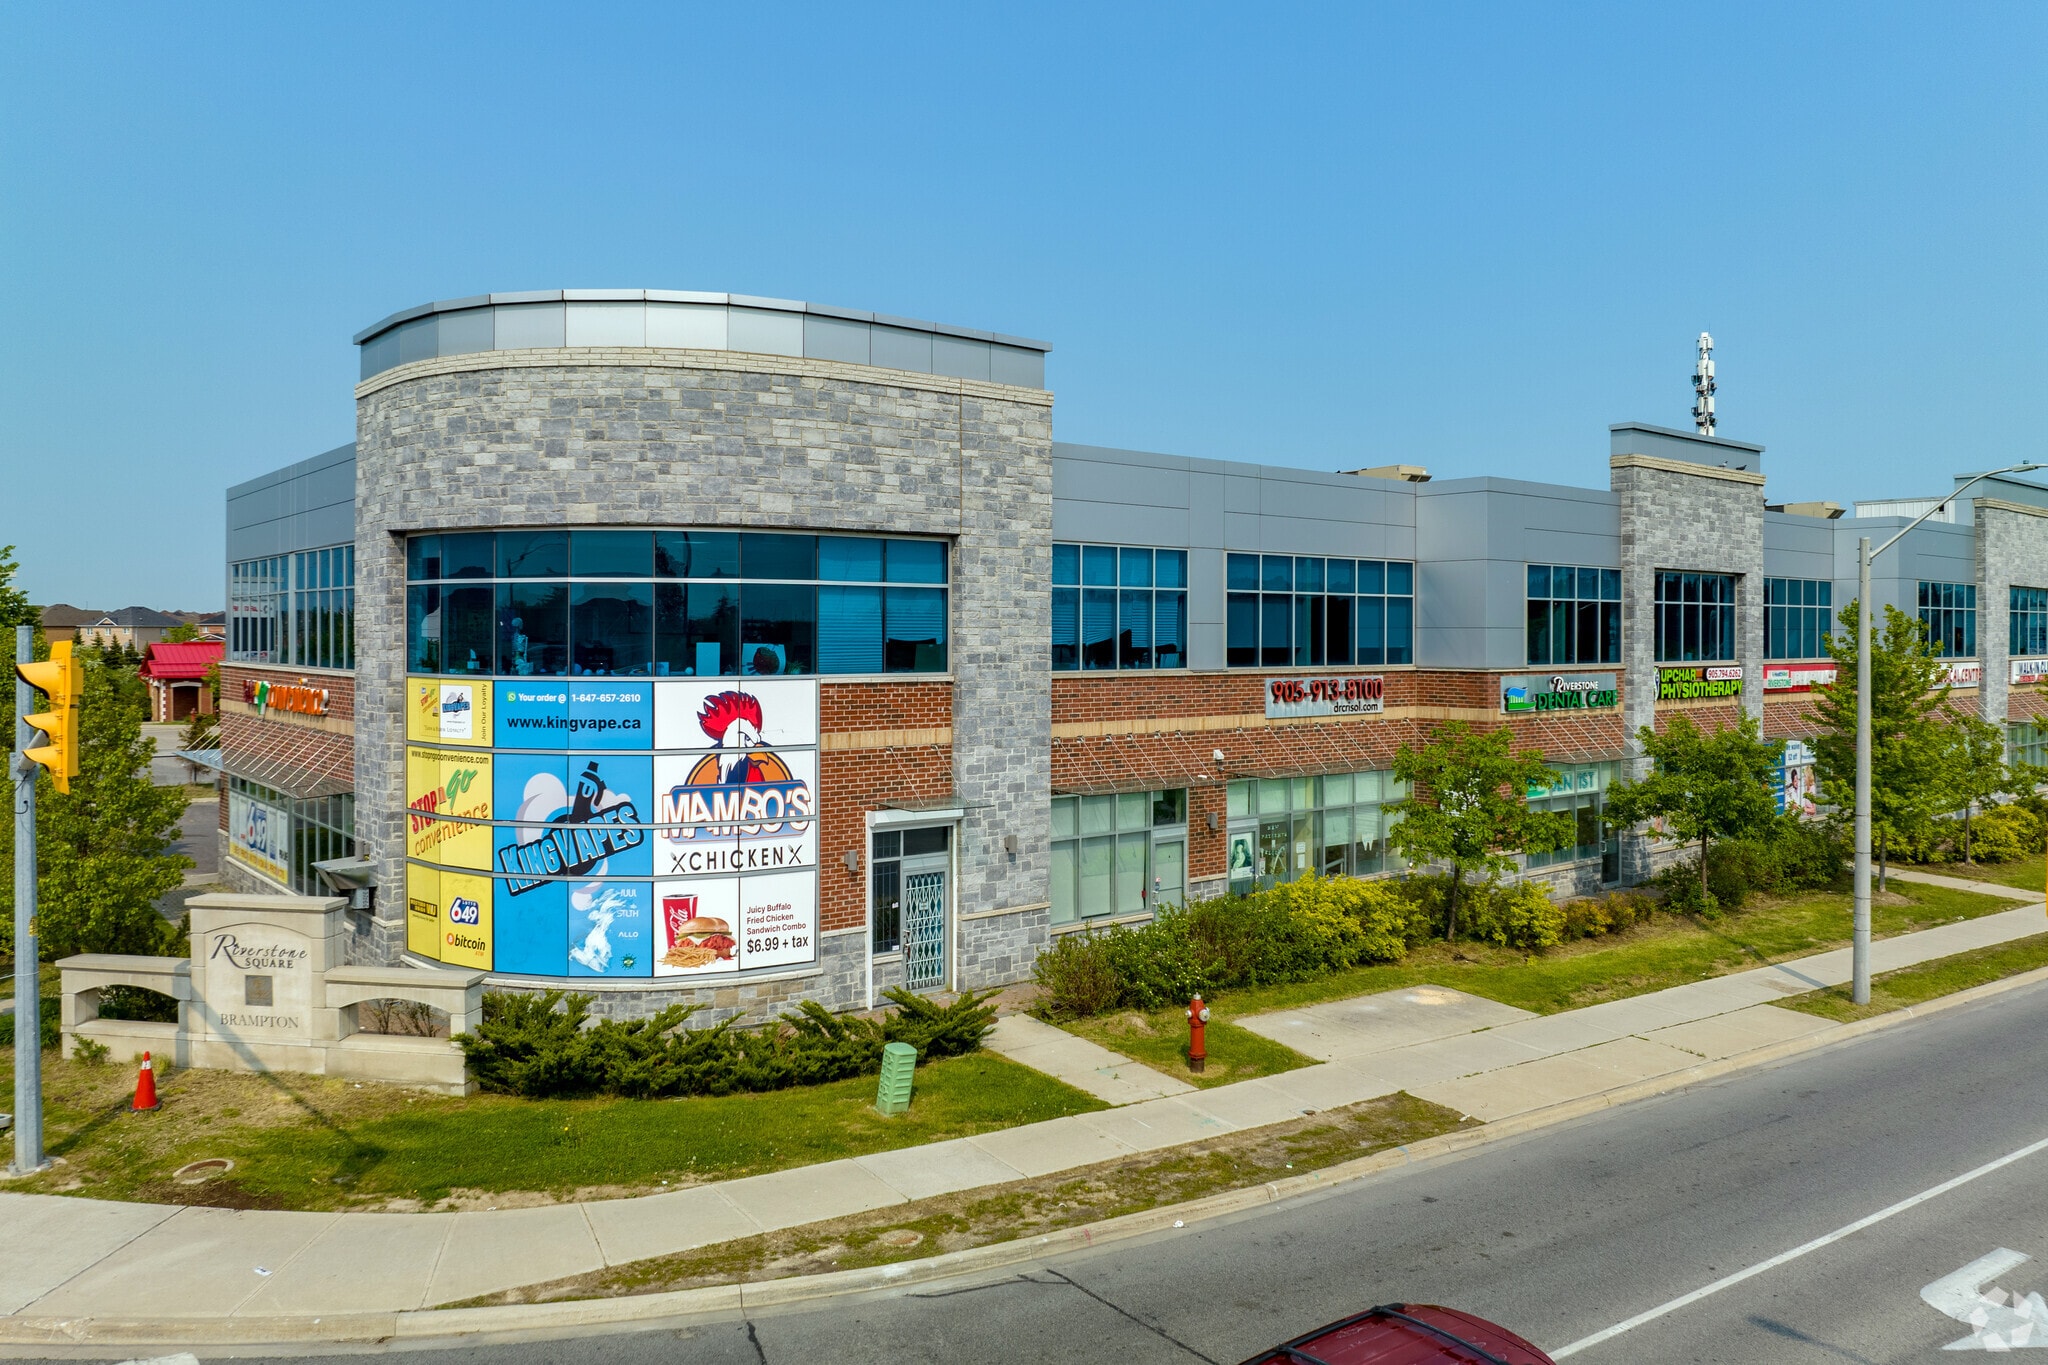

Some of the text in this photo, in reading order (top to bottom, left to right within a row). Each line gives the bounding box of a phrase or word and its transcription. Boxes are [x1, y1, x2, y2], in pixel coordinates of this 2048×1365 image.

[1661, 668, 1696, 682] UPCHAR
[1273, 678, 1383, 704] 905-913-8100
[1553, 676, 1599, 692] RIVERSTONE
[1661, 680, 1743, 699] PHYSIOTHERAPY
[518, 693, 641, 704] Your order @ 1-647-657-2610
[1333, 701, 1379, 713] drcrisol.com
[1537, 689, 1619, 710] DENTAL CARE
[507, 716, 641, 732] www.kingvape.ca
[411, 750, 489, 764] www.stopngoconvenience.com
[410, 769, 478, 834] STOP n go
[661, 786, 811, 840] MAMBO'S
[415, 802, 488, 856] convenience
[500, 804, 641, 894] KINGVAPES
[689, 846, 783, 871] CHICKEN
[746, 902, 792, 914] Juicy Buffalo
[746, 913, 794, 925] Fried Chicken
[746, 922, 806, 935] Sandwich Combo
[455, 933, 486, 951] bitcoin
[747, 936, 779, 954] $6.99
[792, 935, 809, 948] tax
[210, 934, 308, 969] Riverstone
[245, 957, 294, 969] SQUARE
[220, 1013, 299, 1028] BRAMPTON
